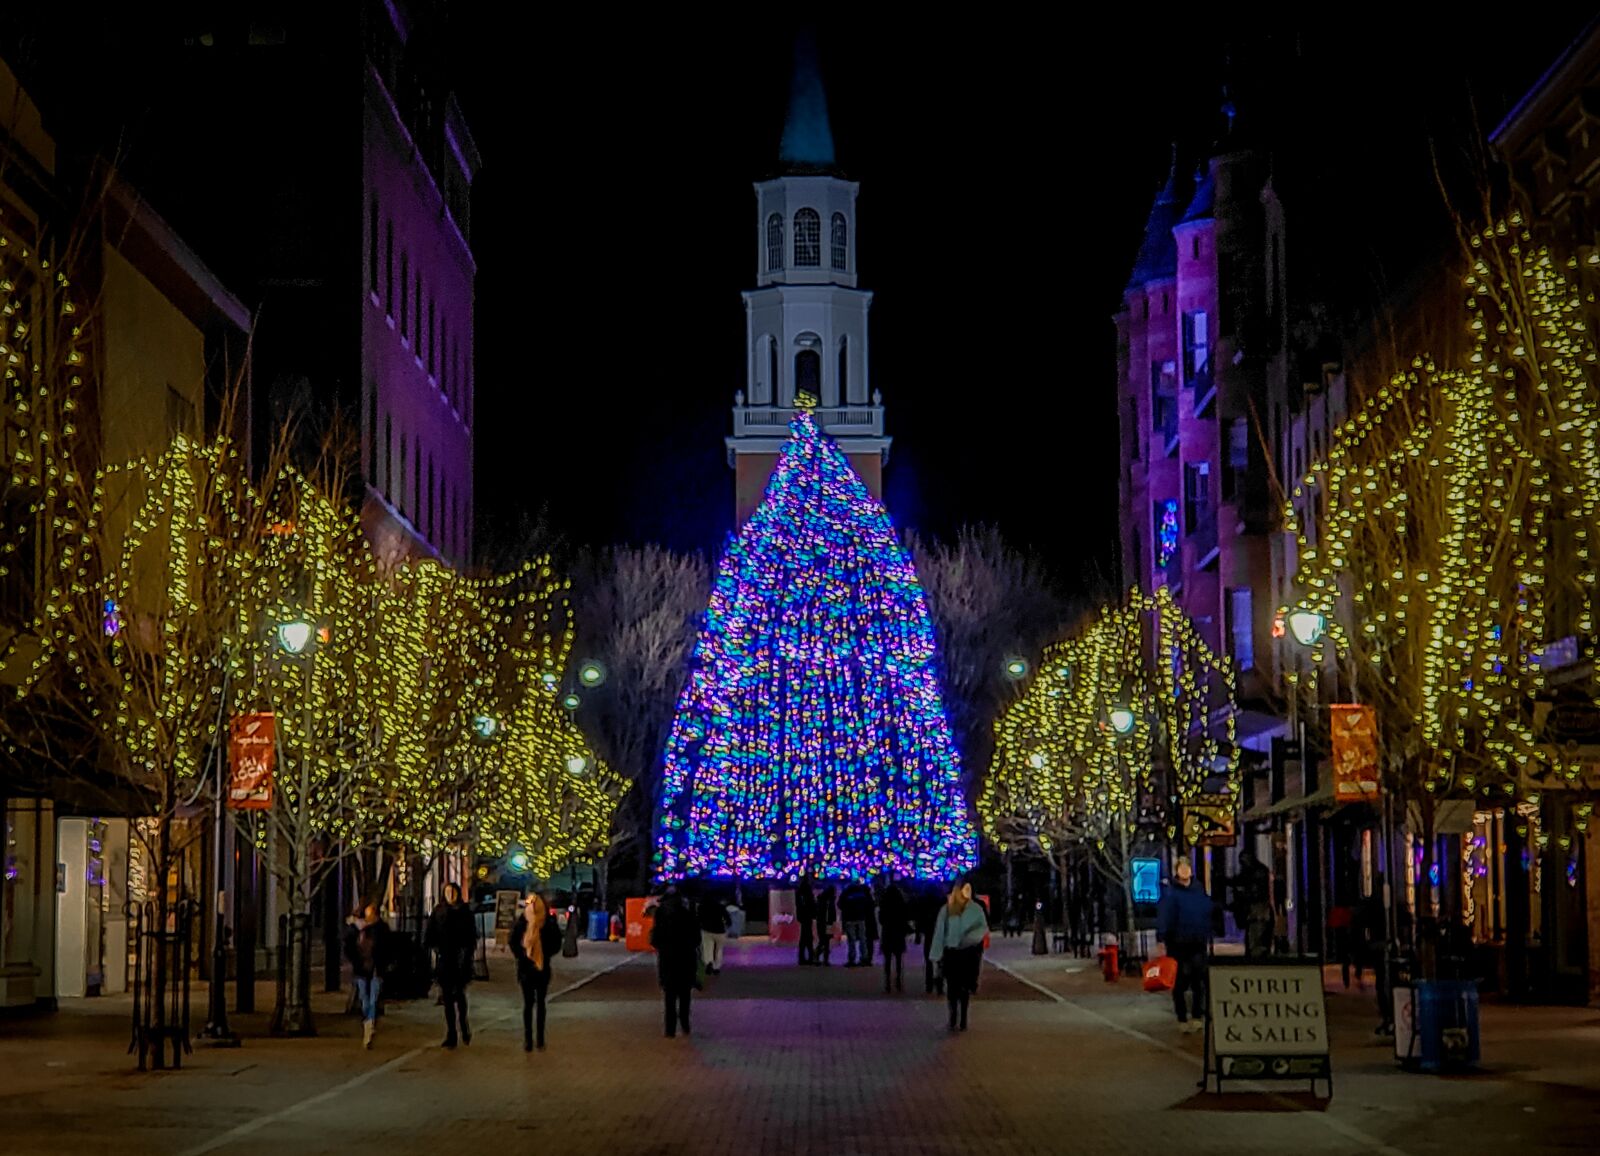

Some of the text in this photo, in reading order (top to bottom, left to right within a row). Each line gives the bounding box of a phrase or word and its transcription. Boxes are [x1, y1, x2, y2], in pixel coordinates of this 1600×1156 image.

[1229, 975, 1304, 995] SPIRIT
[1217, 1001, 1319, 1019] TASTING
[1224, 1023, 1317, 1043] & SALES
